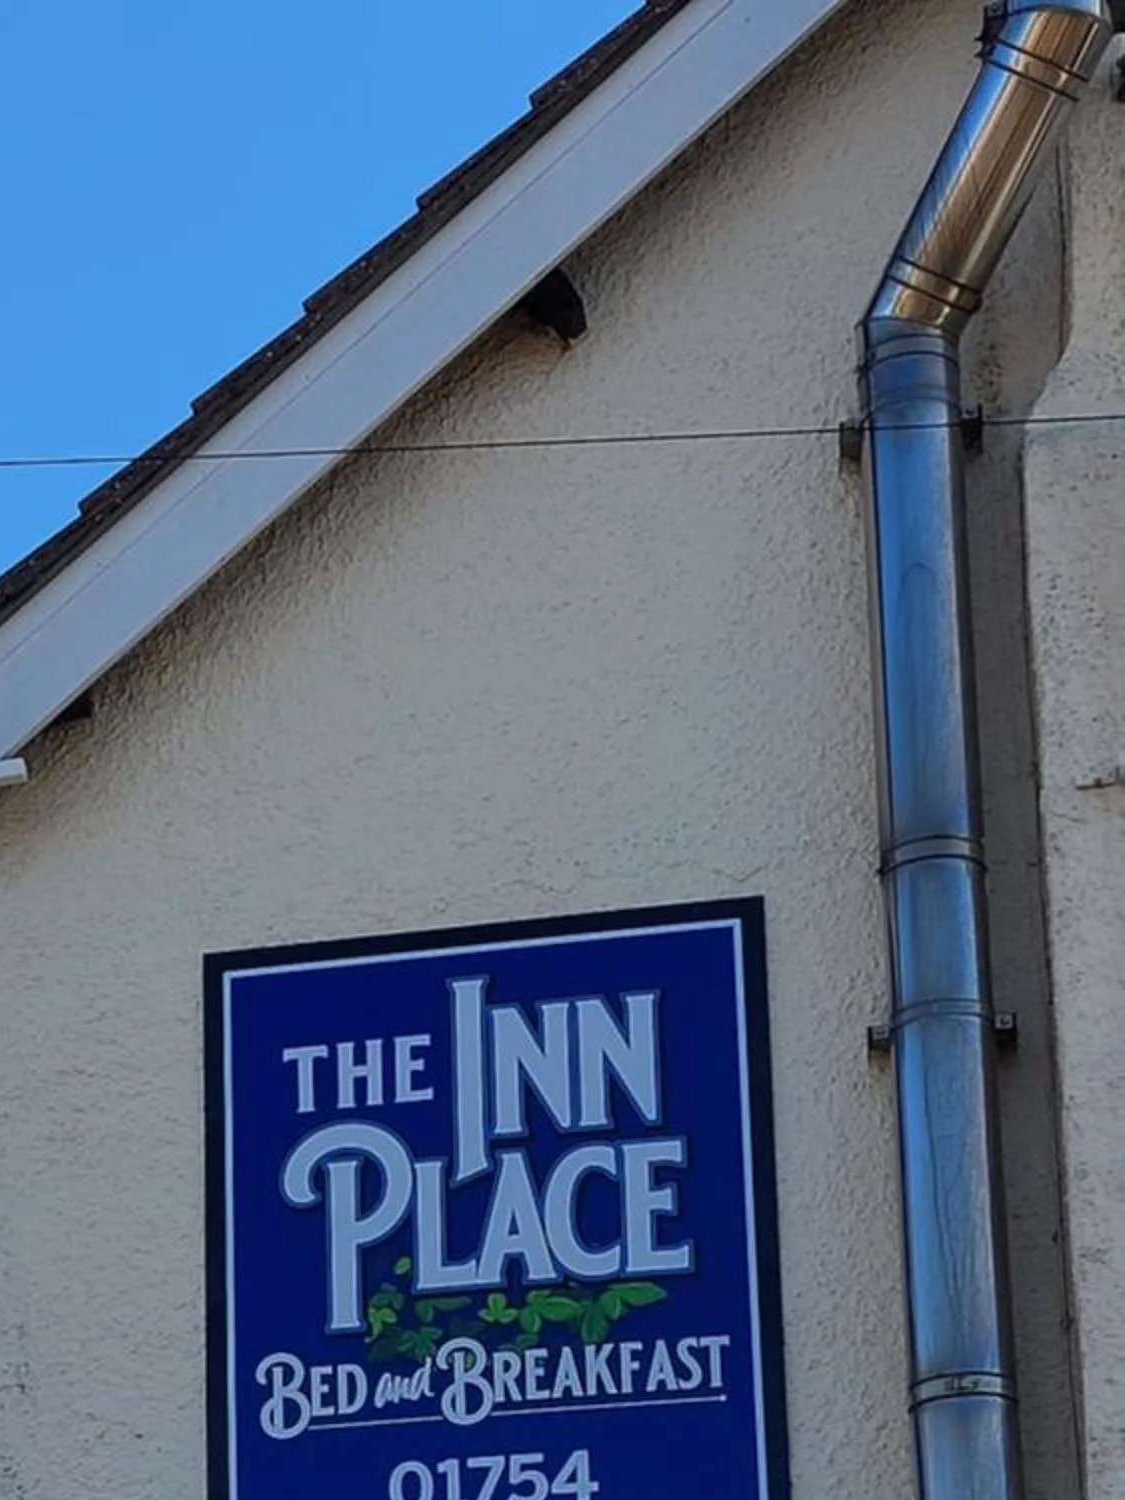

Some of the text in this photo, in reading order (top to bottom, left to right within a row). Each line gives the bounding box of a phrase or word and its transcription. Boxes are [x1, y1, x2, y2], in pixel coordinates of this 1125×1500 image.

[282, 975, 661, 1182] THE INN
[282, 1121, 694, 1333] PLACE
[255, 1336, 730, 1439] BED and BREAKFAST
